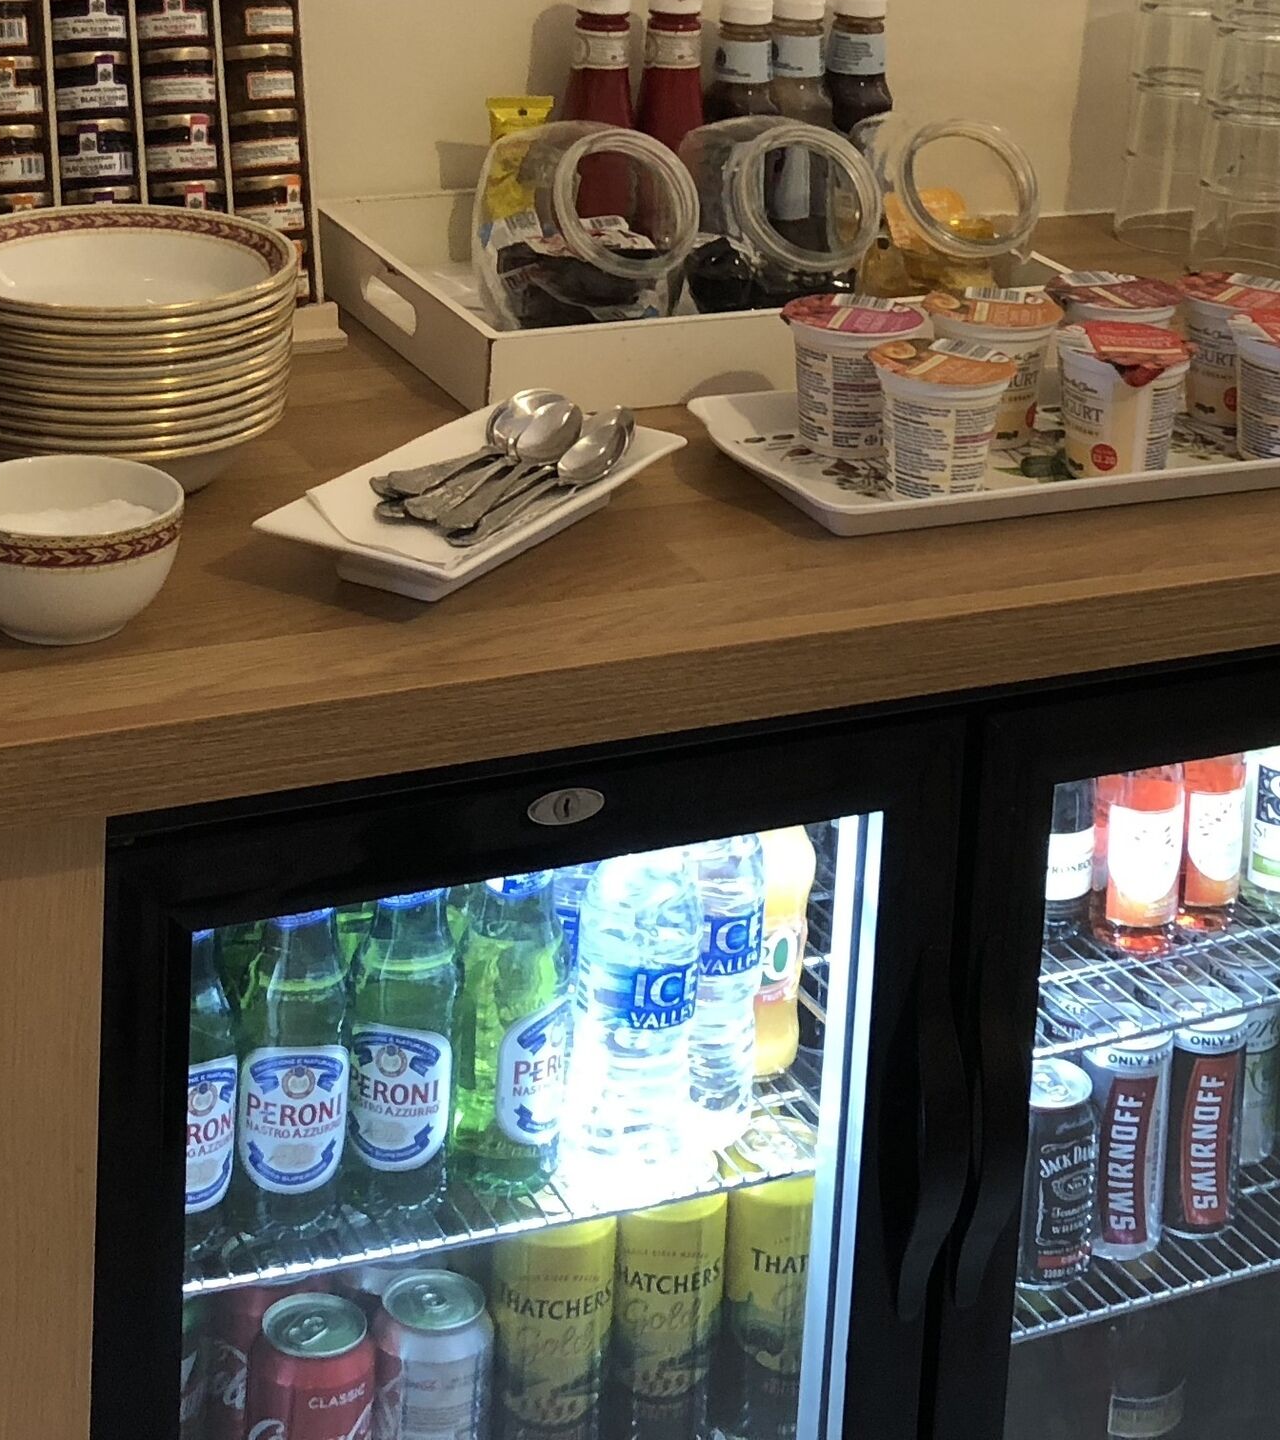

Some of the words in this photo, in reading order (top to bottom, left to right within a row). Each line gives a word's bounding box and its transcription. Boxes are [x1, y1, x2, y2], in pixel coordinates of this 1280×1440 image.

[632, 962, 700, 1009] ICE
[1190, 1033, 1231, 1047] ONLY
[1108, 1053, 1145, 1066] ONLY
[246, 1091, 343, 1127] PERONI
[1189, 1074, 1228, 1212] SMIRNOFF
[1039, 1152, 1073, 1179] JACK
[1106, 1092, 1145, 1233] SMIRNOFF
[500, 1277, 614, 1321] THATCHERS
[623, 1297, 700, 1337] Gold
[307, 1382, 367, 1410] CLASSIC
